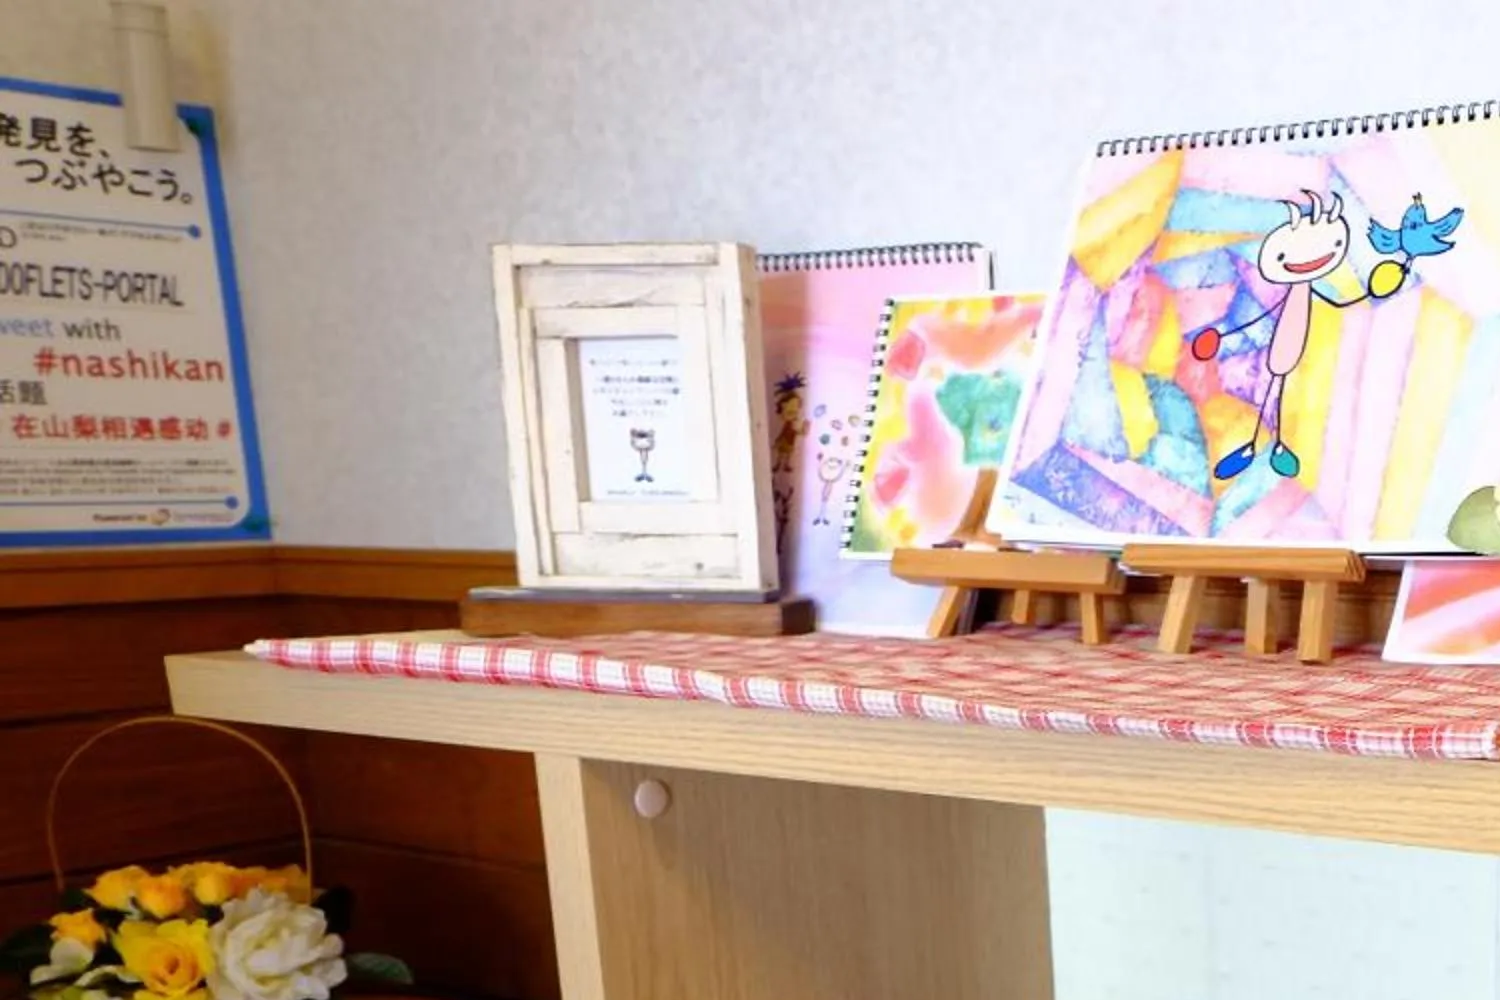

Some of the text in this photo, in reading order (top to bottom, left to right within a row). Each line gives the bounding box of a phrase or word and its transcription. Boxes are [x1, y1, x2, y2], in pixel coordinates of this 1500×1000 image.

[15, 158, 193, 205] つぶやこう。
[62, 317, 121, 341] with
[33, 346, 225, 382] #nashikan
